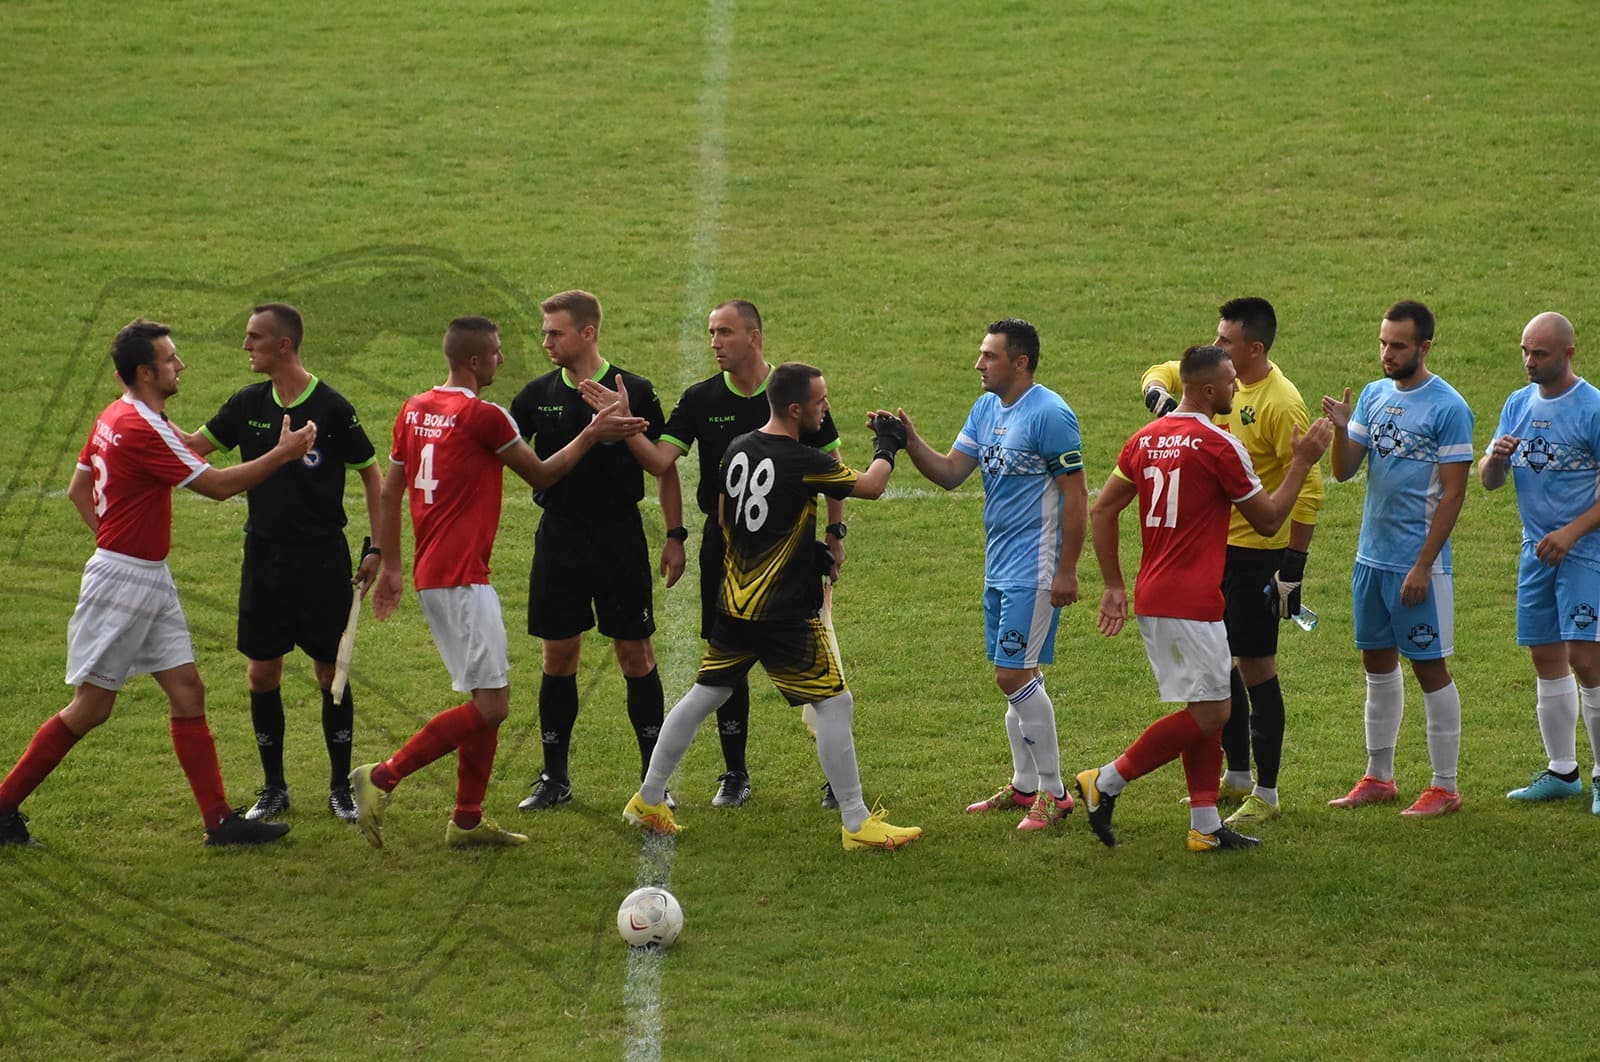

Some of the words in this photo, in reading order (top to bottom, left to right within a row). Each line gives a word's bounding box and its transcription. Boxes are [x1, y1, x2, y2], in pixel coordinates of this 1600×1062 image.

[406, 412, 419, 424] FK
[708, 415, 736, 423] KELME
[1157, 435, 1202, 449] BORAC
[1148, 449, 1179, 459] TETOVO
[414, 443, 439, 505] 4
[726, 451, 775, 533] 98
[1143, 466, 1181, 529] 21
